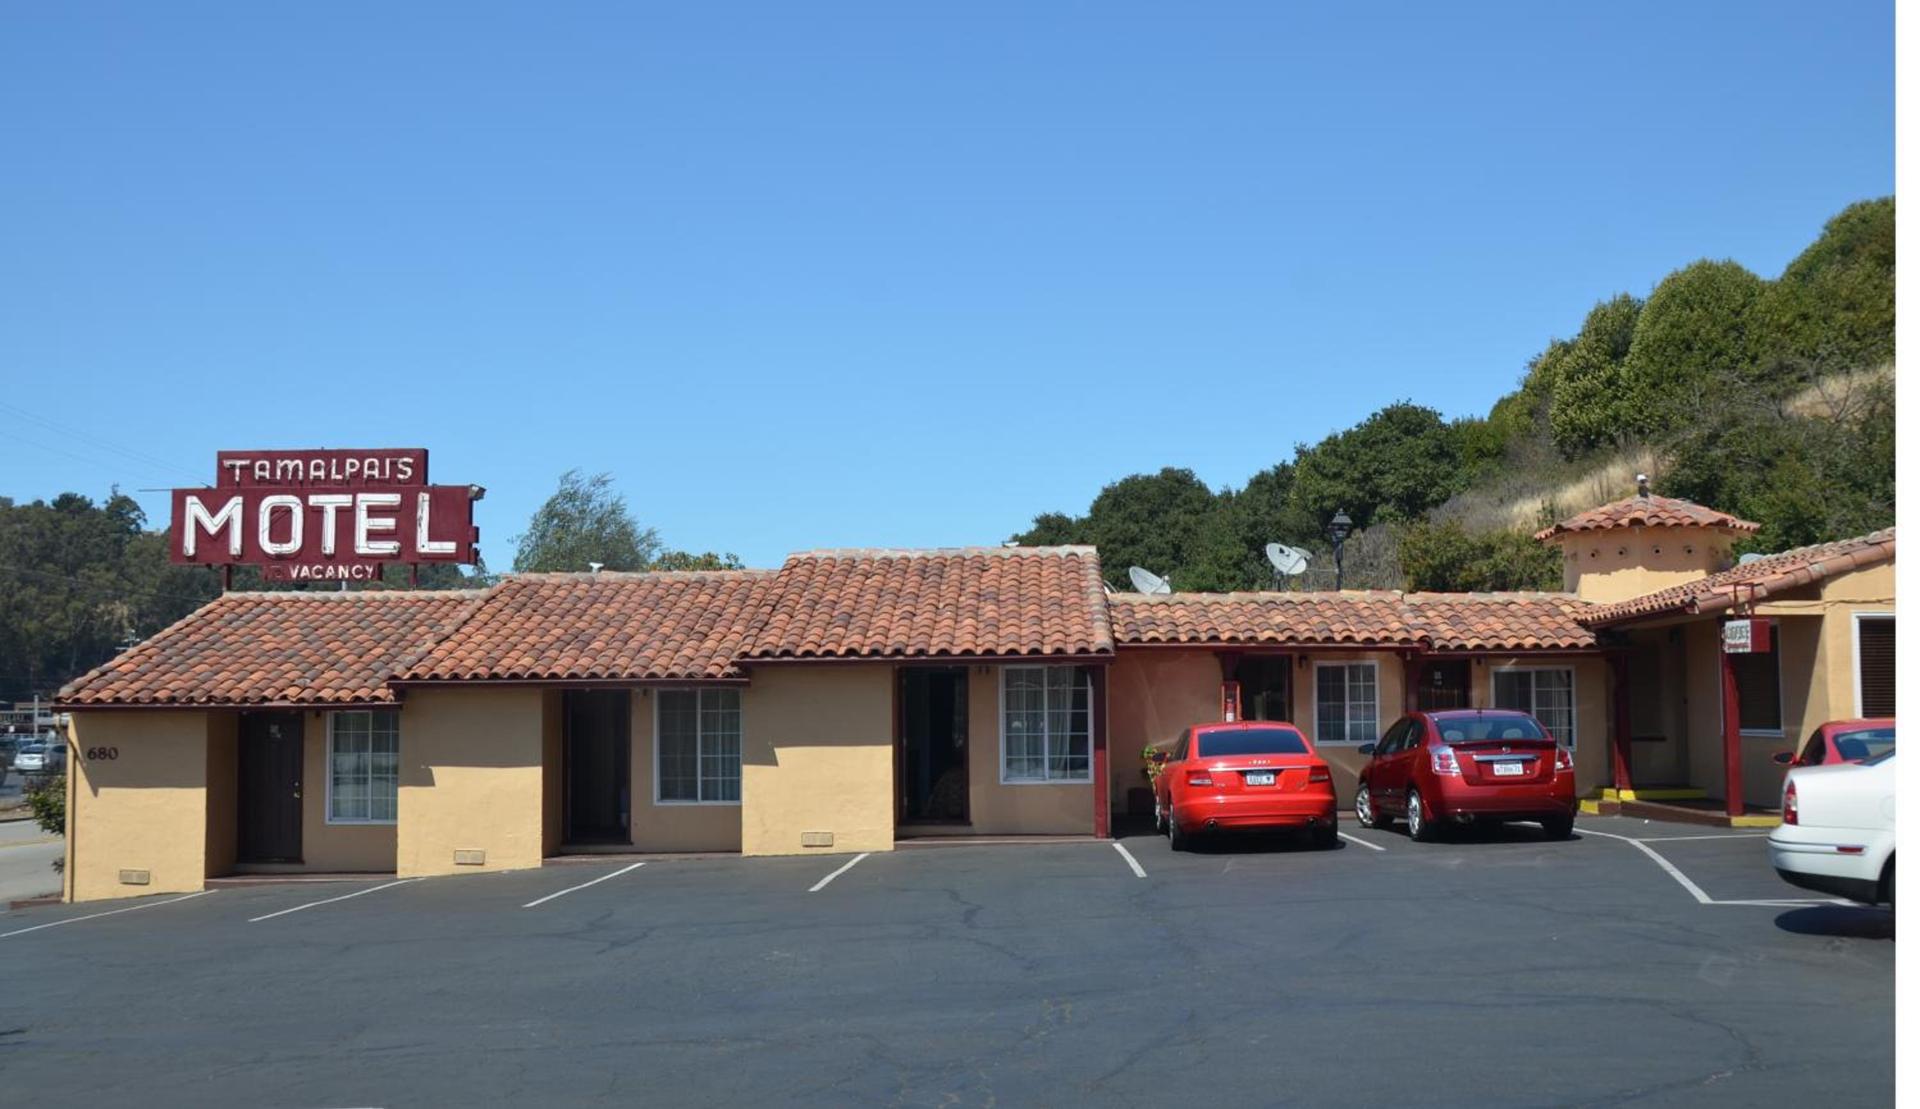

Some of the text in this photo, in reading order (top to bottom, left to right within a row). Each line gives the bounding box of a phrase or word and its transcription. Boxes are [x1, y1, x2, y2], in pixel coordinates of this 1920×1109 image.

[223, 457, 414, 482] TAMALPAIS
[183, 492, 457, 556] MOTEL
[289, 564, 375, 579] VACANCY
[87, 746, 119, 760] 680
